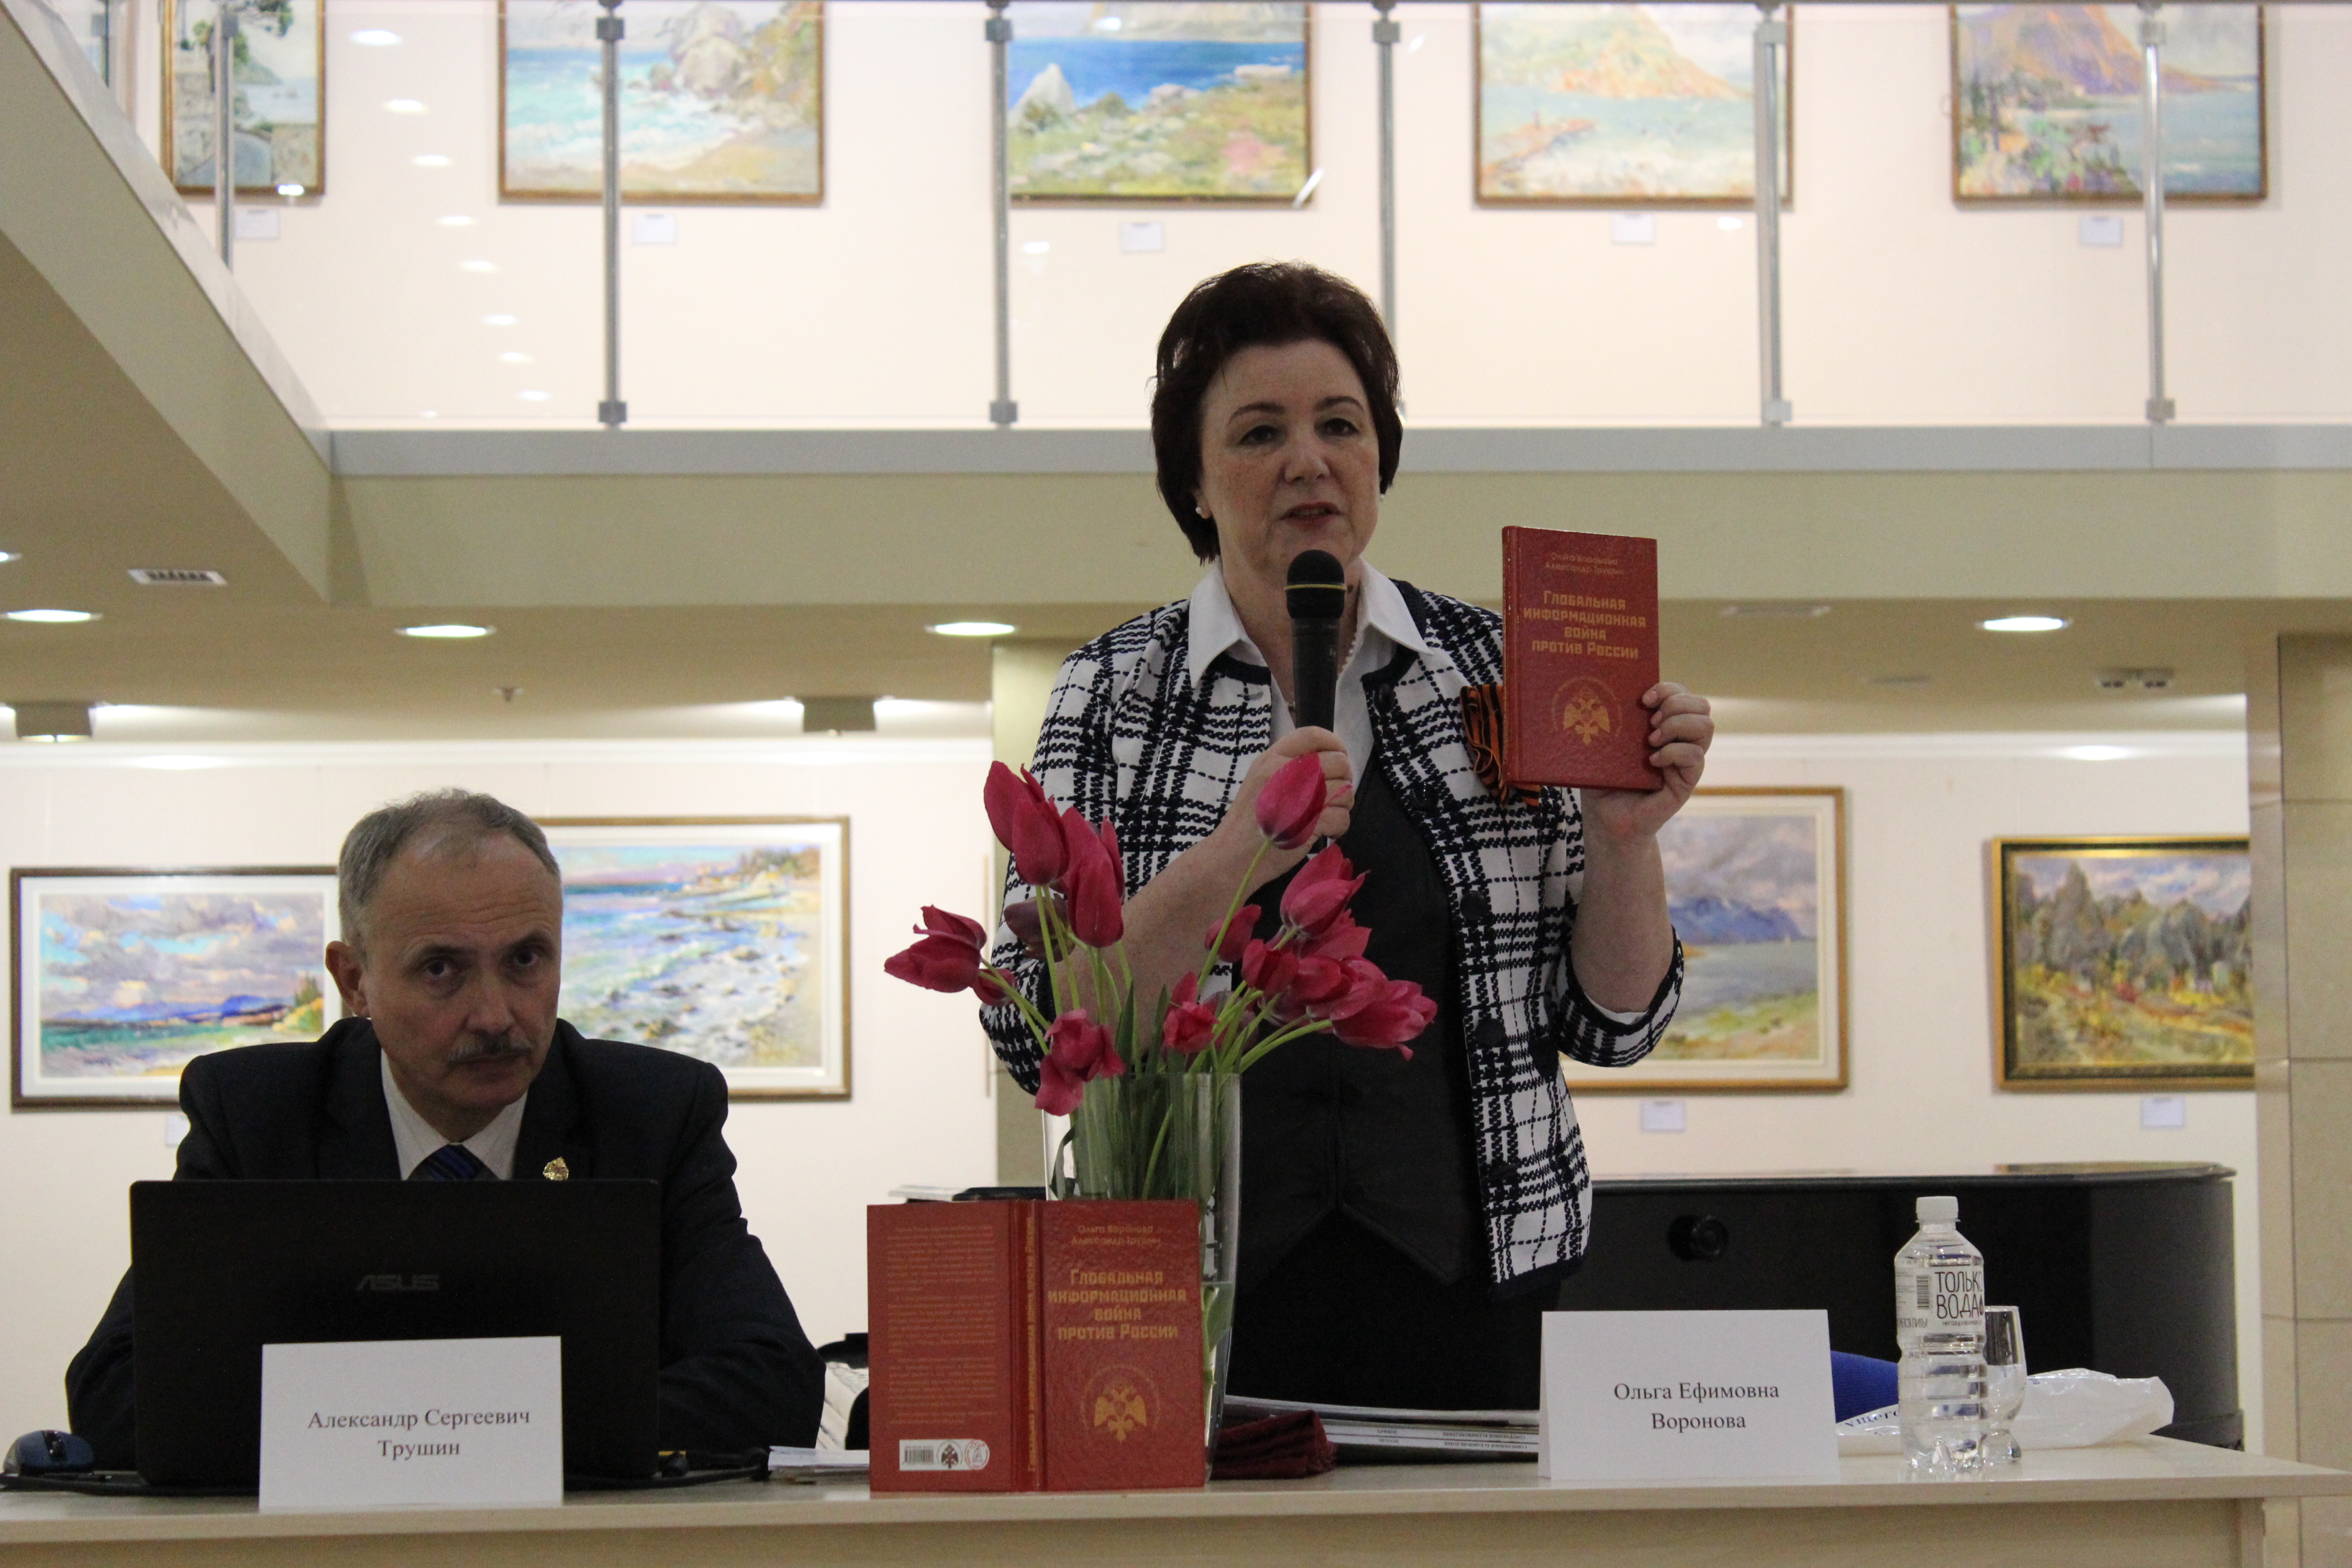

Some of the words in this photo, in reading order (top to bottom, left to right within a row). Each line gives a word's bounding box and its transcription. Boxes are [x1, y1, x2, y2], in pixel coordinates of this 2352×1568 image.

[355, 1274, 440, 1292] ASUS
[1936, 1294, 1980, 1320] ВОДА
[1614, 1384, 1672, 1400] Ольга
[1680, 1382, 1779, 1403] Ефимовна
[308, 1412, 418, 1431] Александр
[425, 1409, 529, 1430] Сергеевич
[1652, 1413, 1746, 1433] Воронова
[378, 1440, 459, 1460] Трушин
